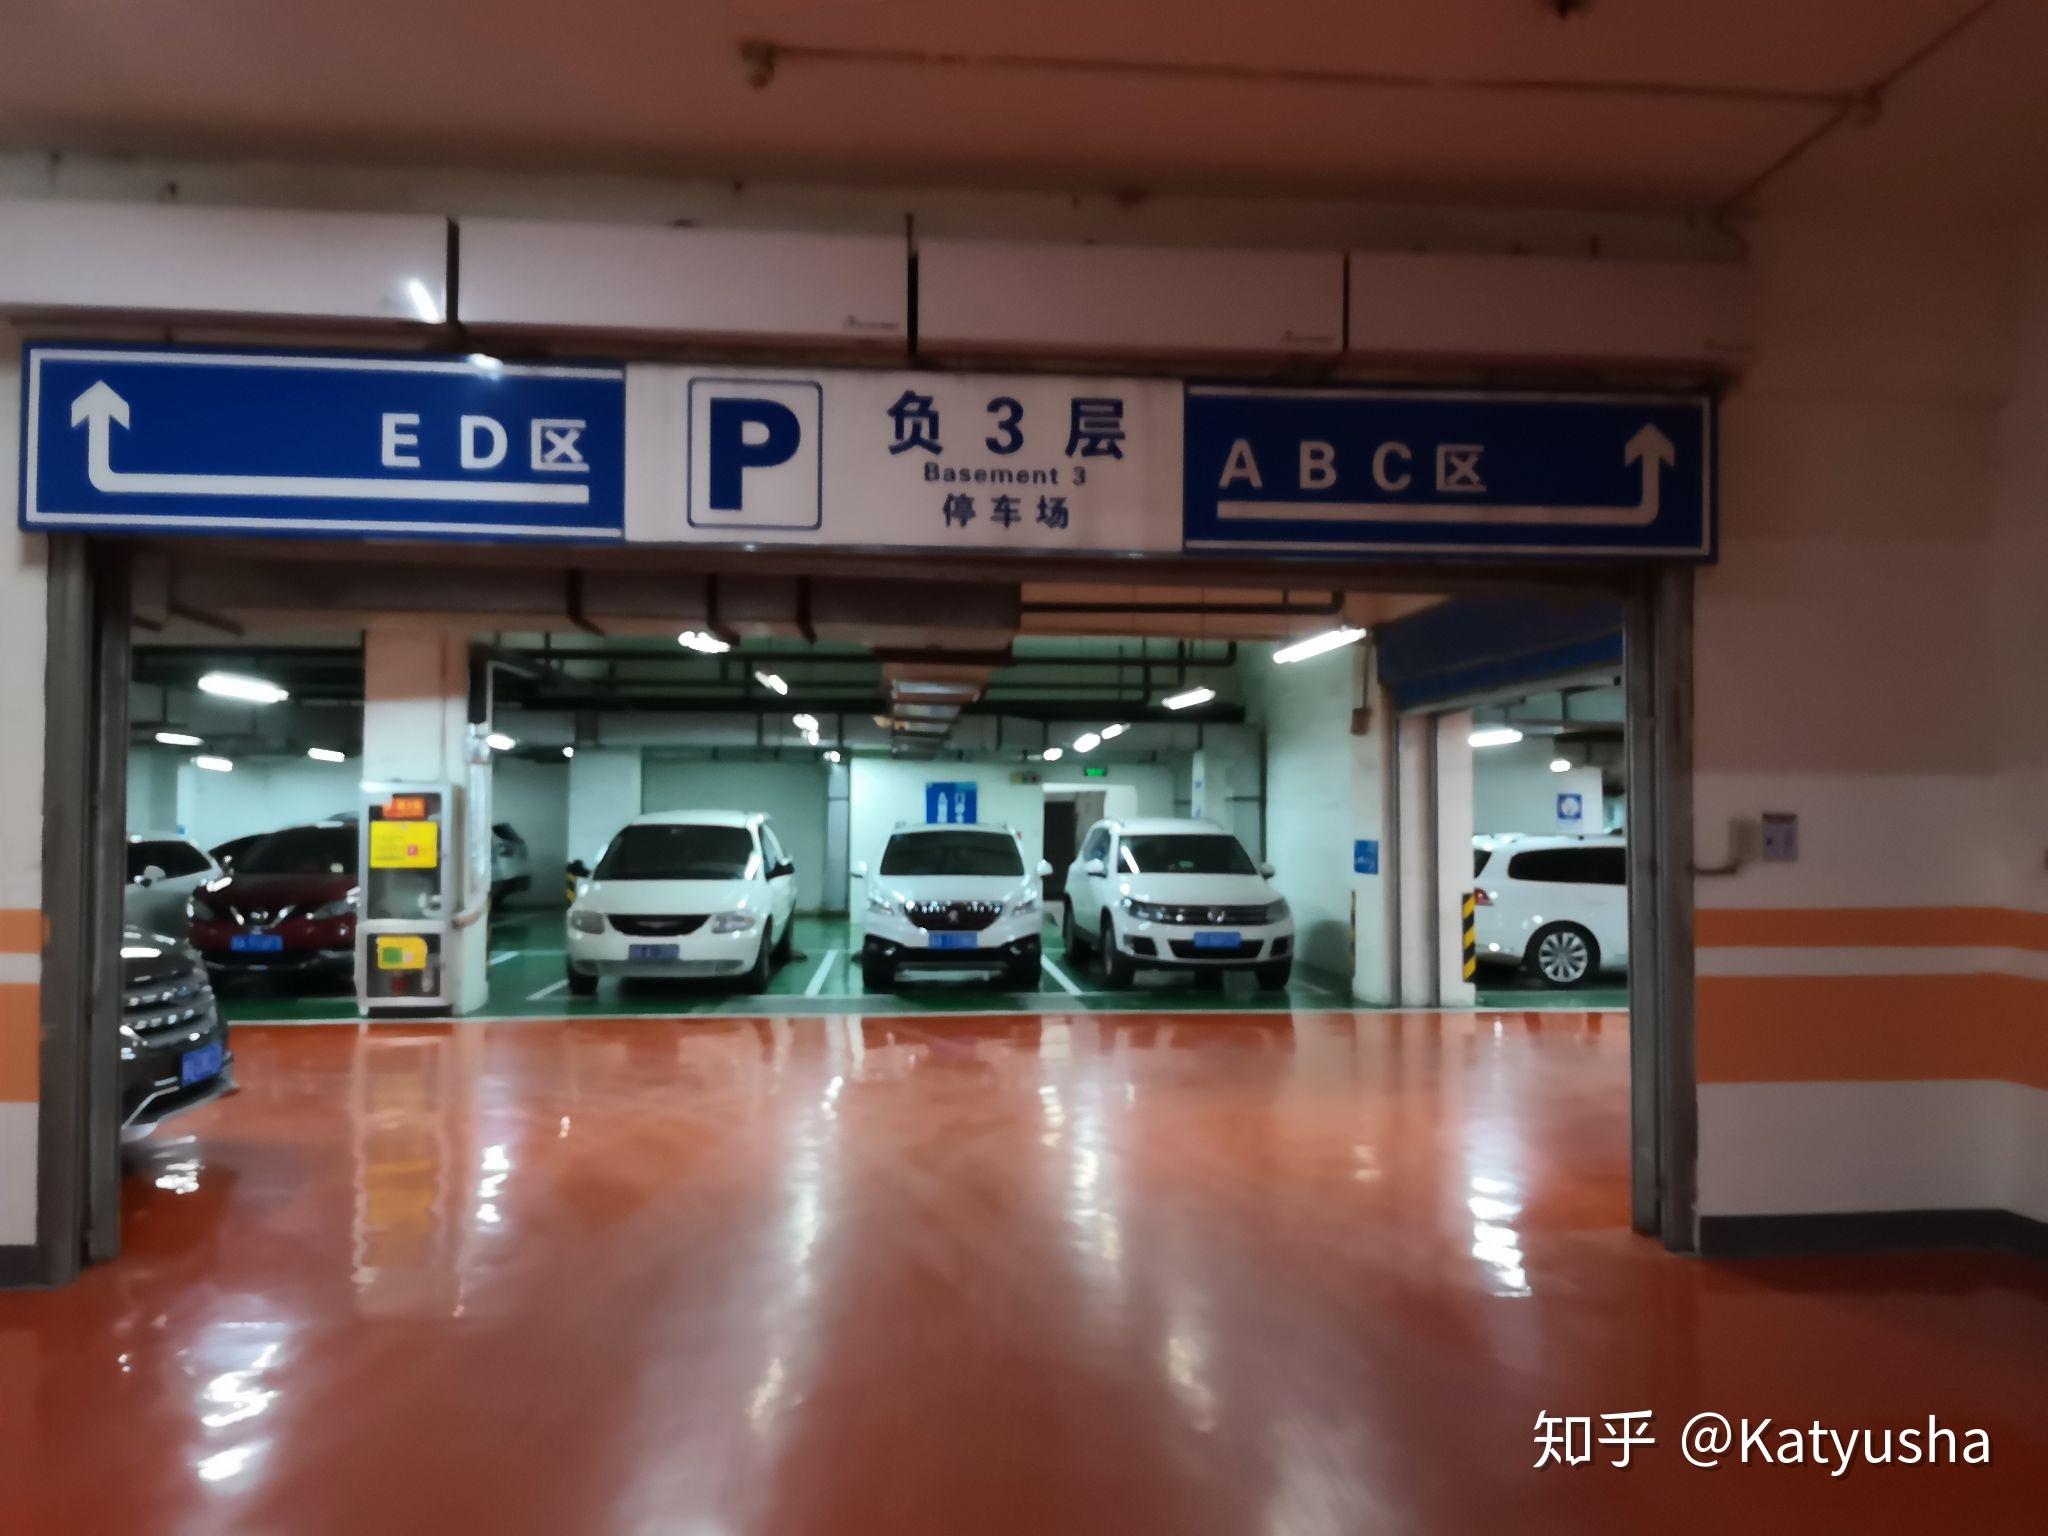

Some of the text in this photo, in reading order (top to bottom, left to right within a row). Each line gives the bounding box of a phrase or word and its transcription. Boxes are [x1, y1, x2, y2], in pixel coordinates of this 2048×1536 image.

[709, 397, 801, 511] P
[924, 462, 1087, 486] Basement 3
[943, 492, 1070, 530] 停车场
